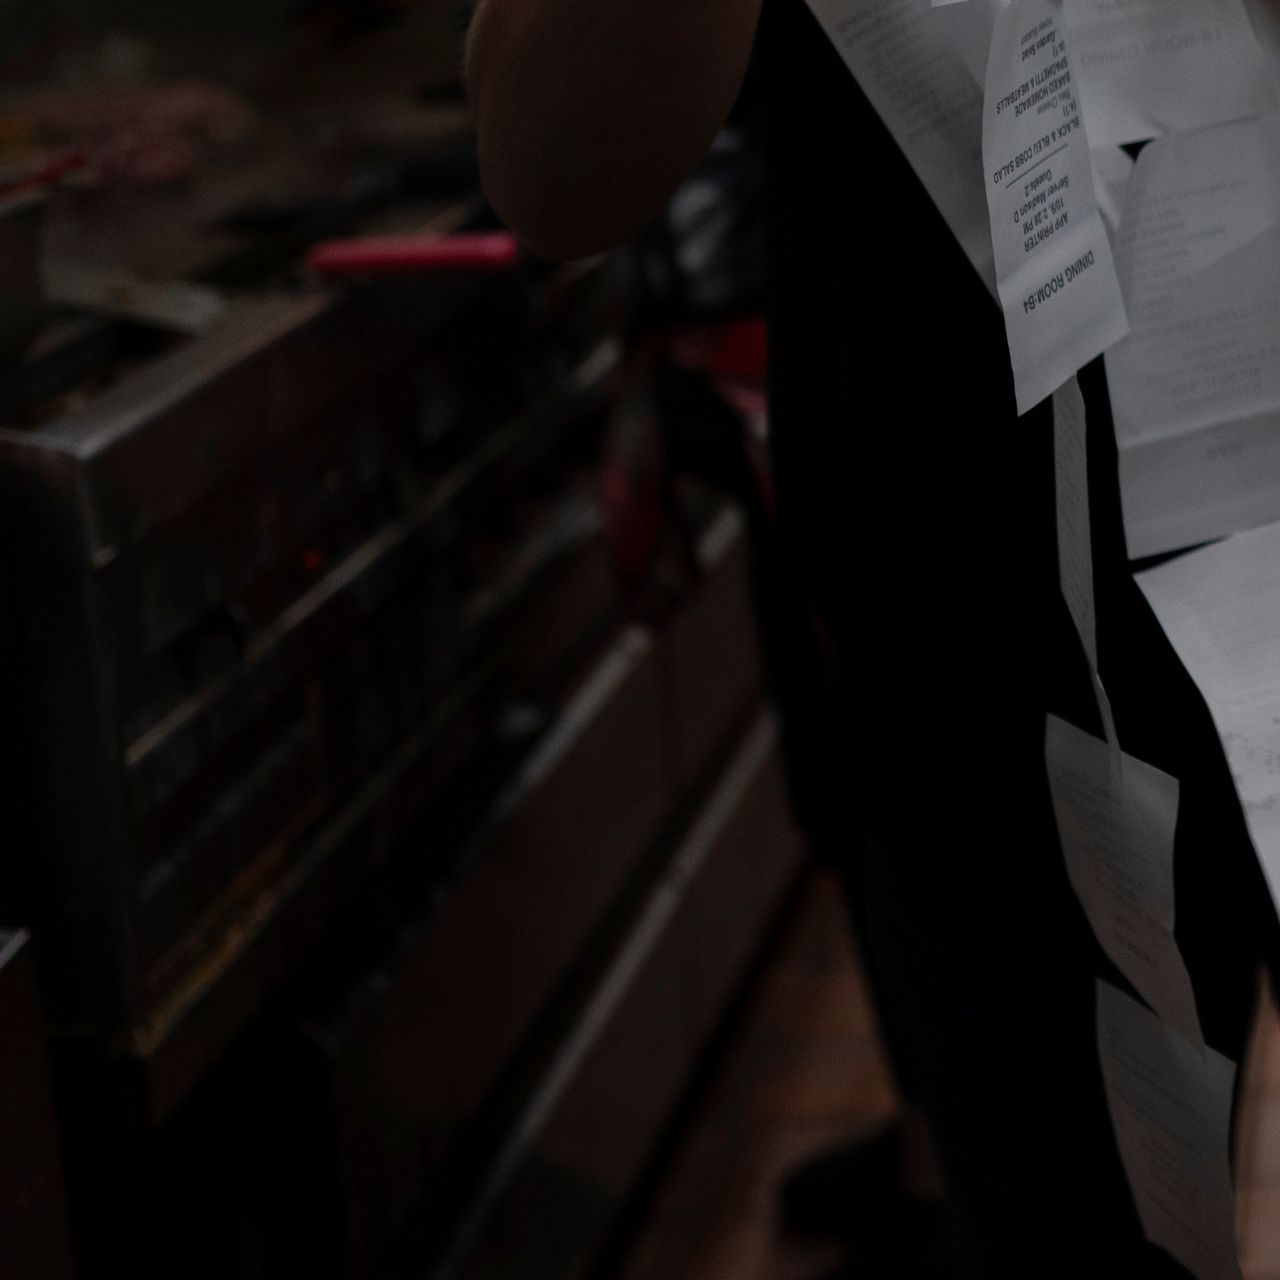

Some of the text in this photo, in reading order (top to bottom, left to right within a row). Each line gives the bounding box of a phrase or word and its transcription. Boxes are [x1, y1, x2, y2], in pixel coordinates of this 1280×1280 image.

[1034, 56, 1068, 86] SPAGHETTI
[996, 81, 1030, 115] MEATBALLS
[1014, 71, 1071, 118] BAKED HOMEMADE
[1057, 116, 1080, 139] BLACK
[1033, 135, 1050, 152] BLEU
[1015, 147, 1033, 168] COBB
[993, 160, 1014, 184] SALAD
[1014, 210, 1019, 223] D
[1022, 222, 1033, 236] PM
[1024, 211, 1068, 252] APP PRINTER
[1023, 250, 1095, 314] DINING ROOM:B4
